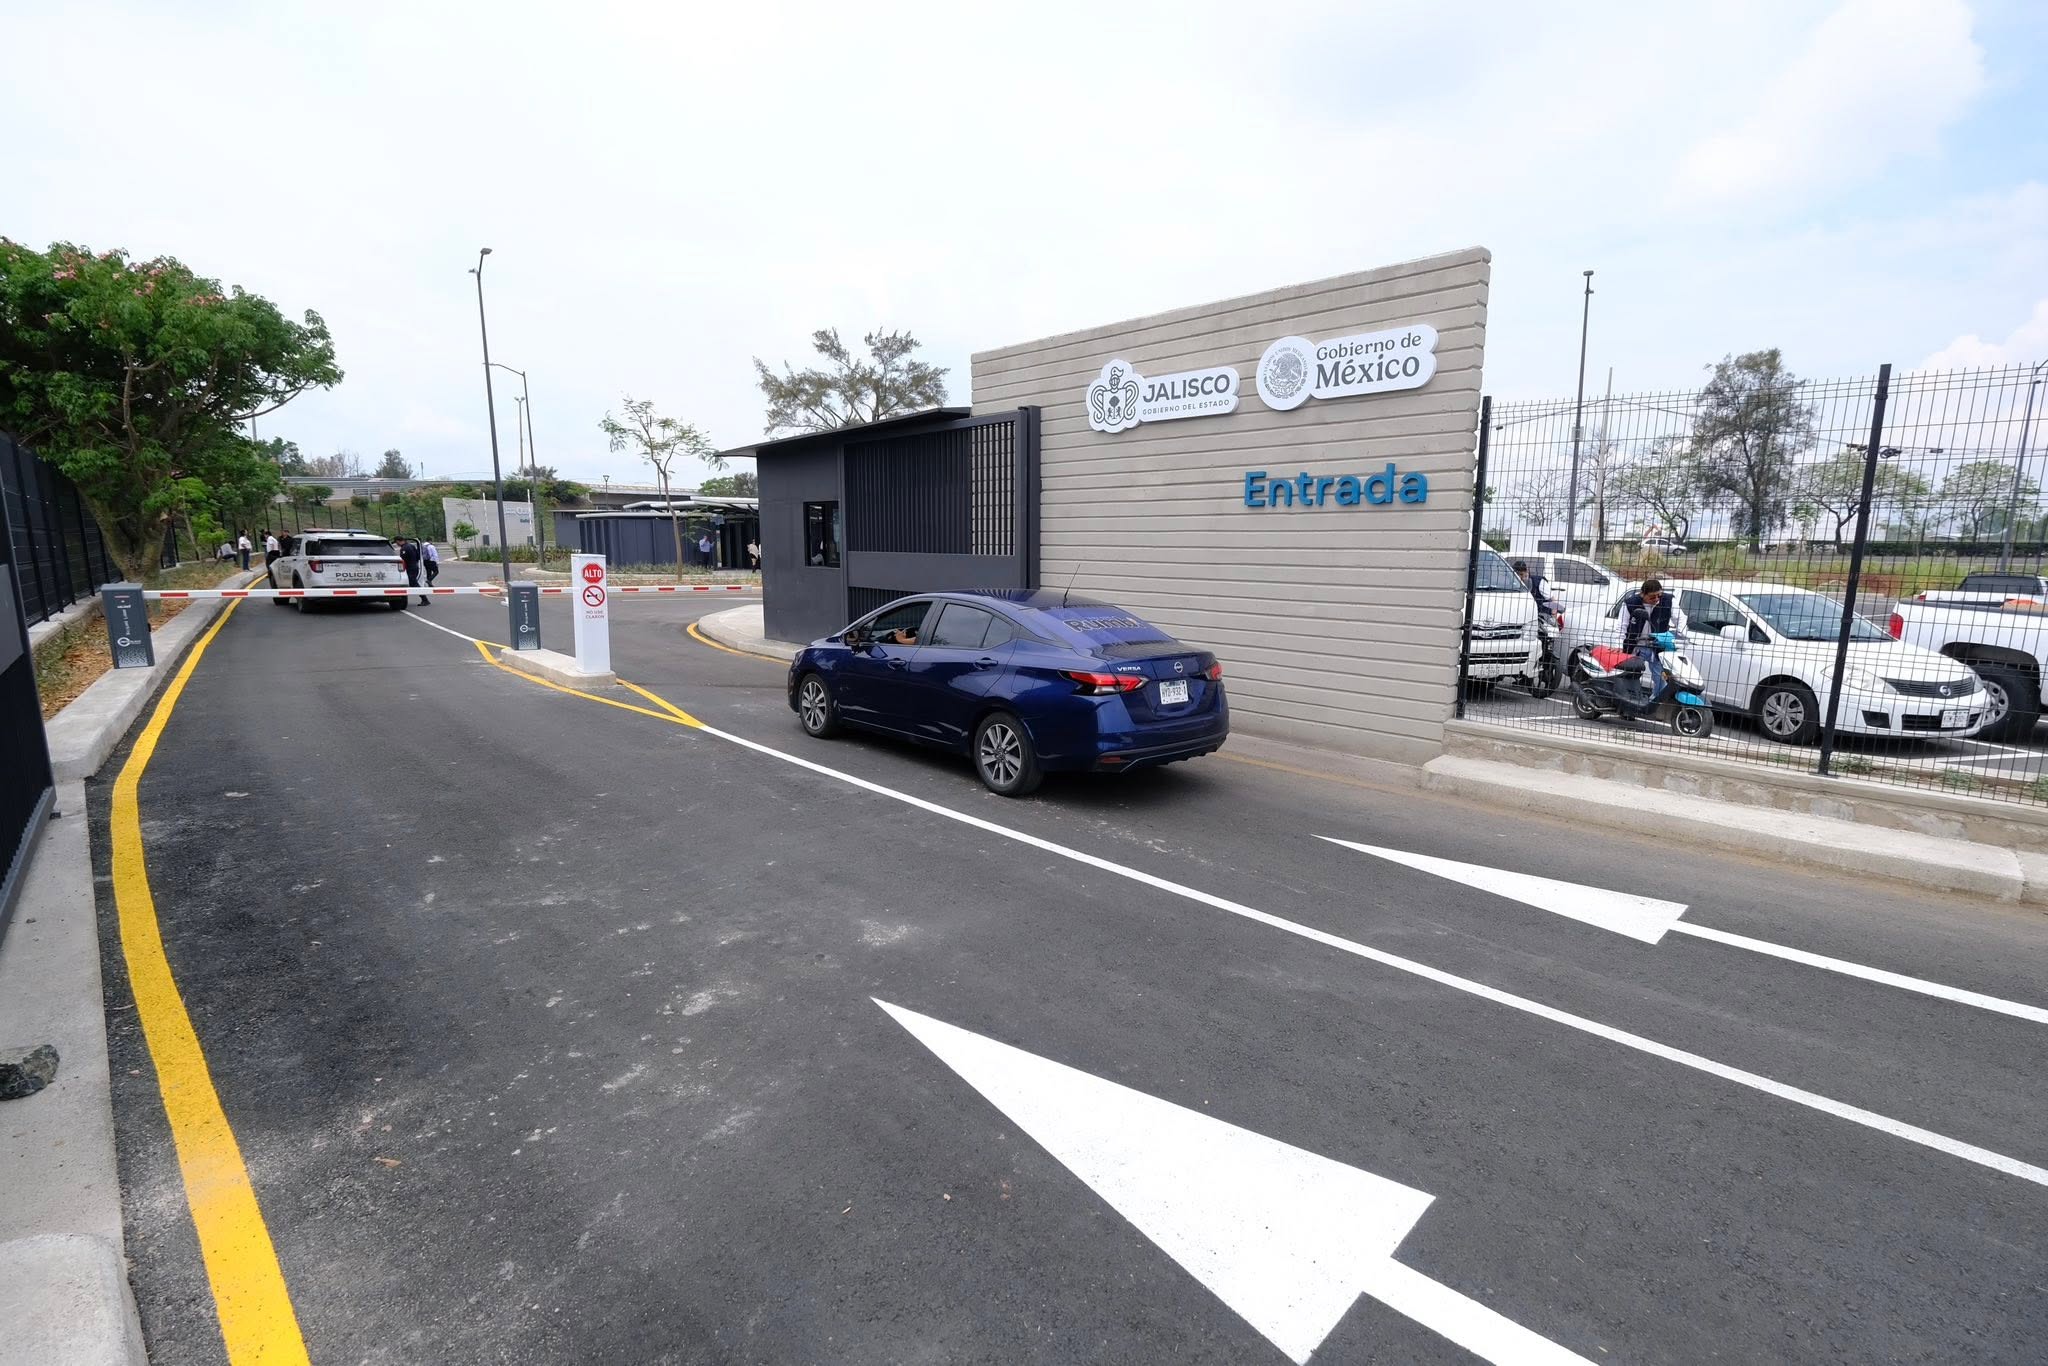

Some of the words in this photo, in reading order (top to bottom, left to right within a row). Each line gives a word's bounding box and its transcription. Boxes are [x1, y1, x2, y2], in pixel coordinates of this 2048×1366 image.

[1316, 338, 1396, 361] Gobierno
[1400, 332, 1422, 349] de
[1315, 353, 1420, 390] México
[1142, 373, 1231, 403] JALISCO
[1142, 405, 1180, 416] GOBIERNO
[1182, 402, 1196, 411] DEL
[1198, 398, 1230, 409] ESTADO
[1244, 462, 1428, 508] Entrada
[584, 568, 602, 578] ALTO
